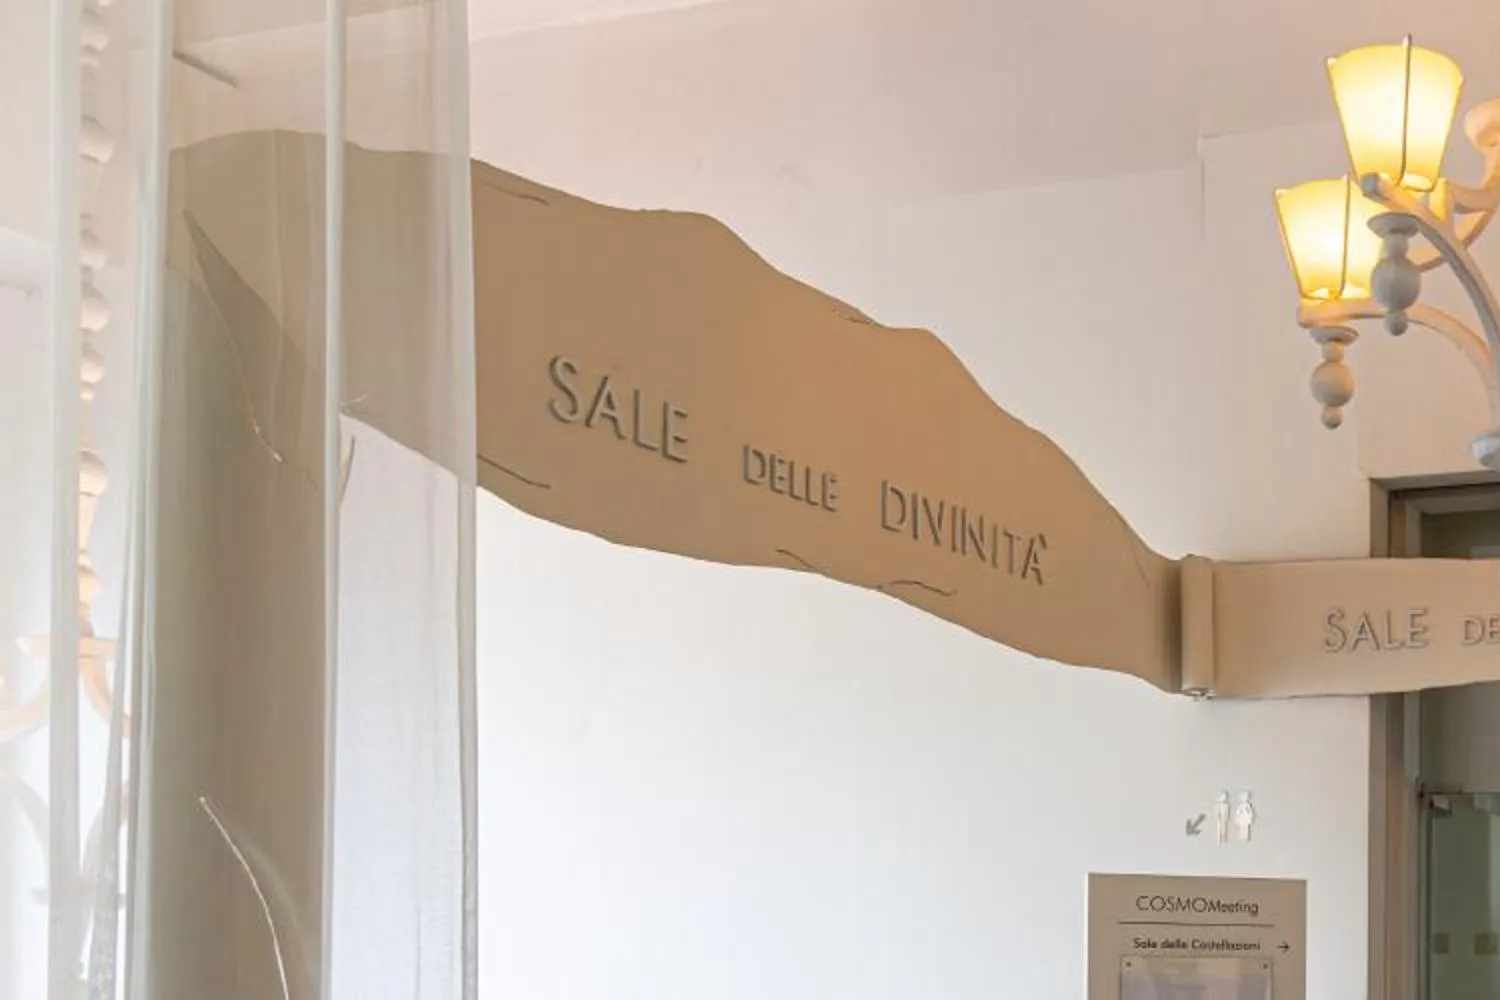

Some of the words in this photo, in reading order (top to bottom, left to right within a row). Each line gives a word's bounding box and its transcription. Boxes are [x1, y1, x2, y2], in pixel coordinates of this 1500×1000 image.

[548, 354, 689, 463] SALE
[743, 444, 838, 512] DELLE
[1323, 606, 1429, 653] SALE
[1135, 895, 1260, 916] COSMOMeeting
